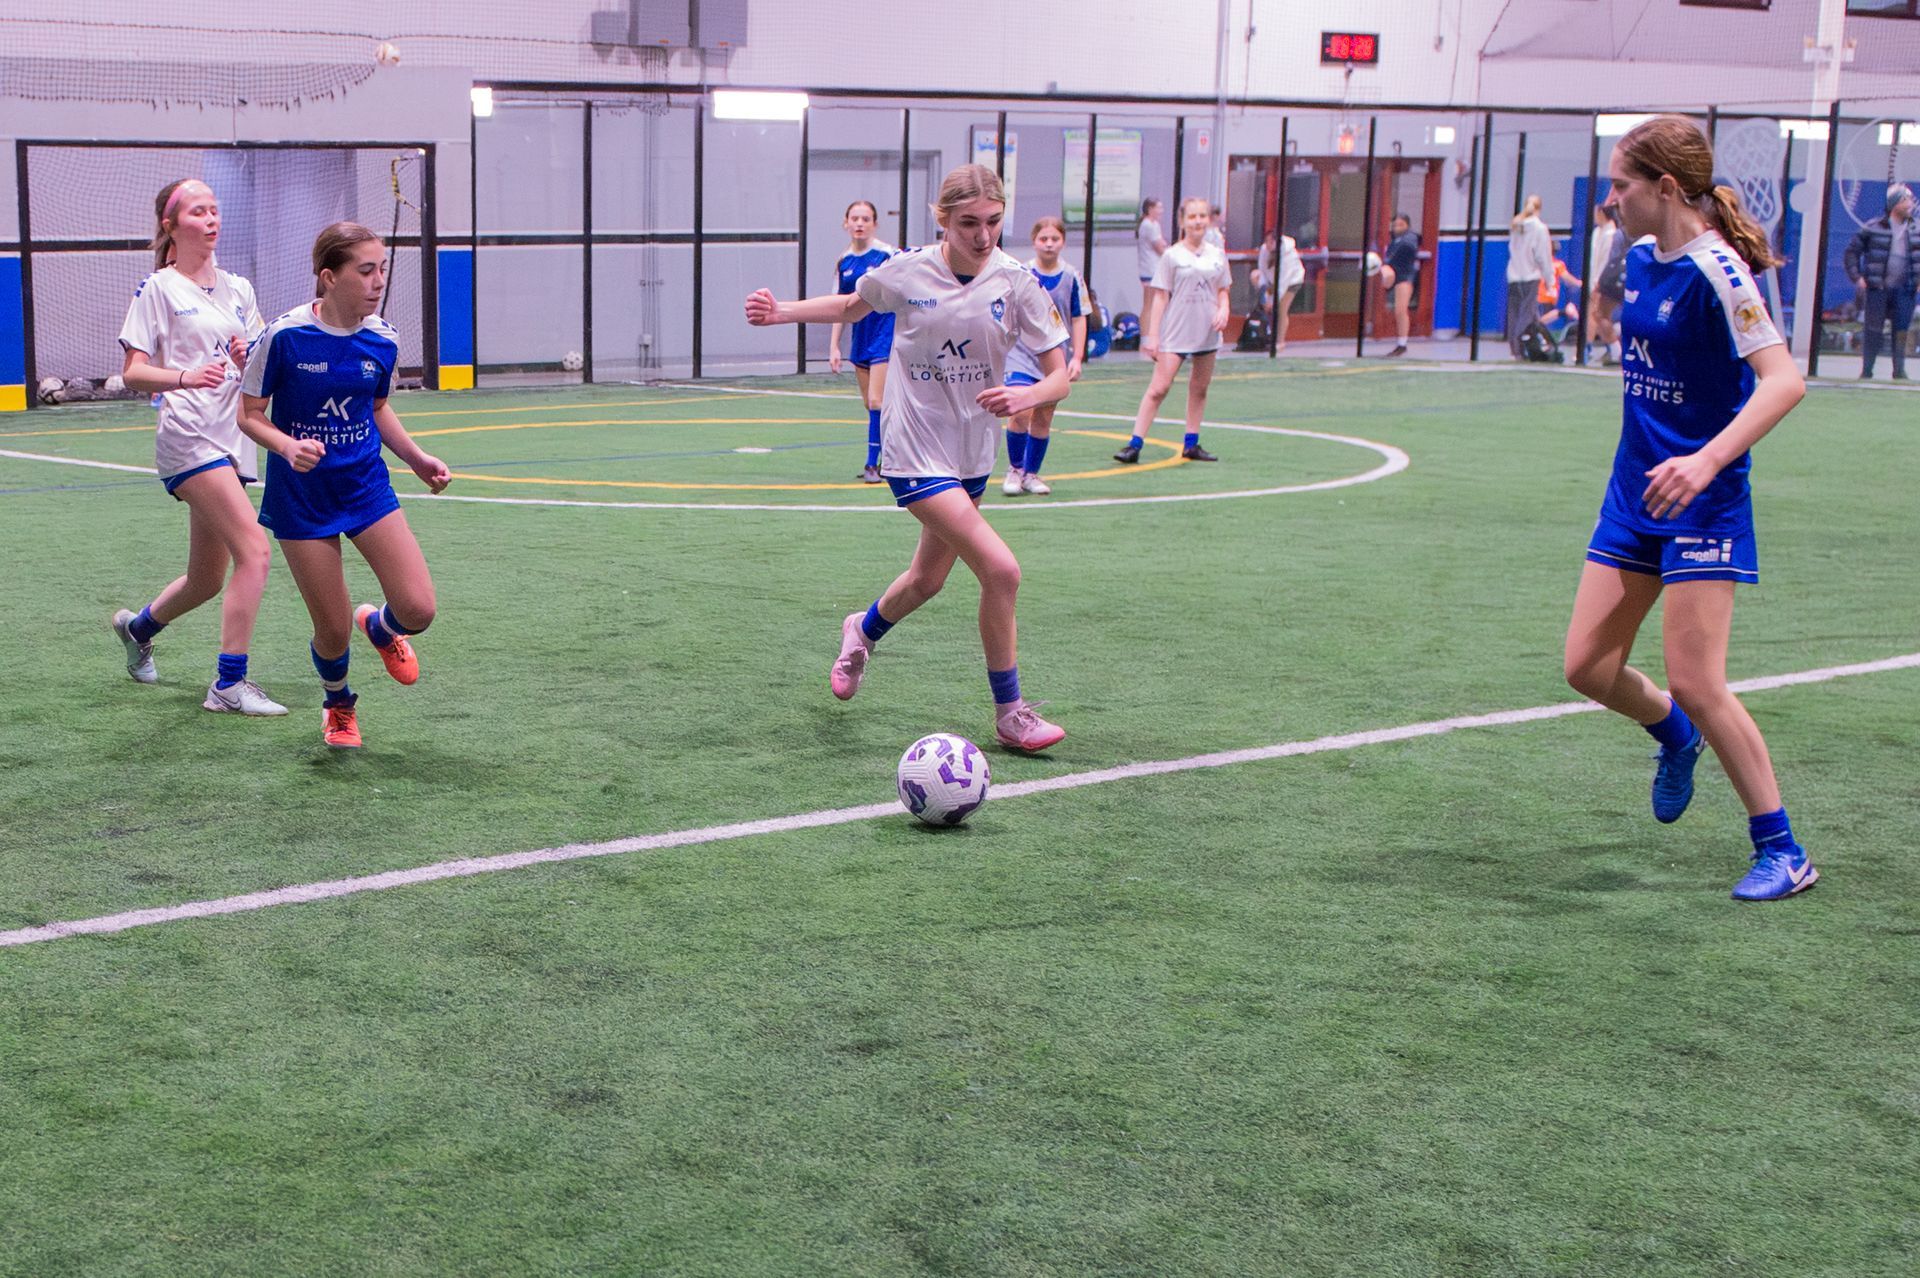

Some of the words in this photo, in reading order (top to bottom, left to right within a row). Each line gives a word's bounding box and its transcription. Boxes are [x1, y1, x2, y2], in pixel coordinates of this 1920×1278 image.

[936, 338, 972, 359] AK
[297, 361, 328, 373] capelli
[911, 369, 992, 384] LOGISTICS
[1624, 381, 1685, 405] ISTICS
[317, 396, 353, 421] AK
